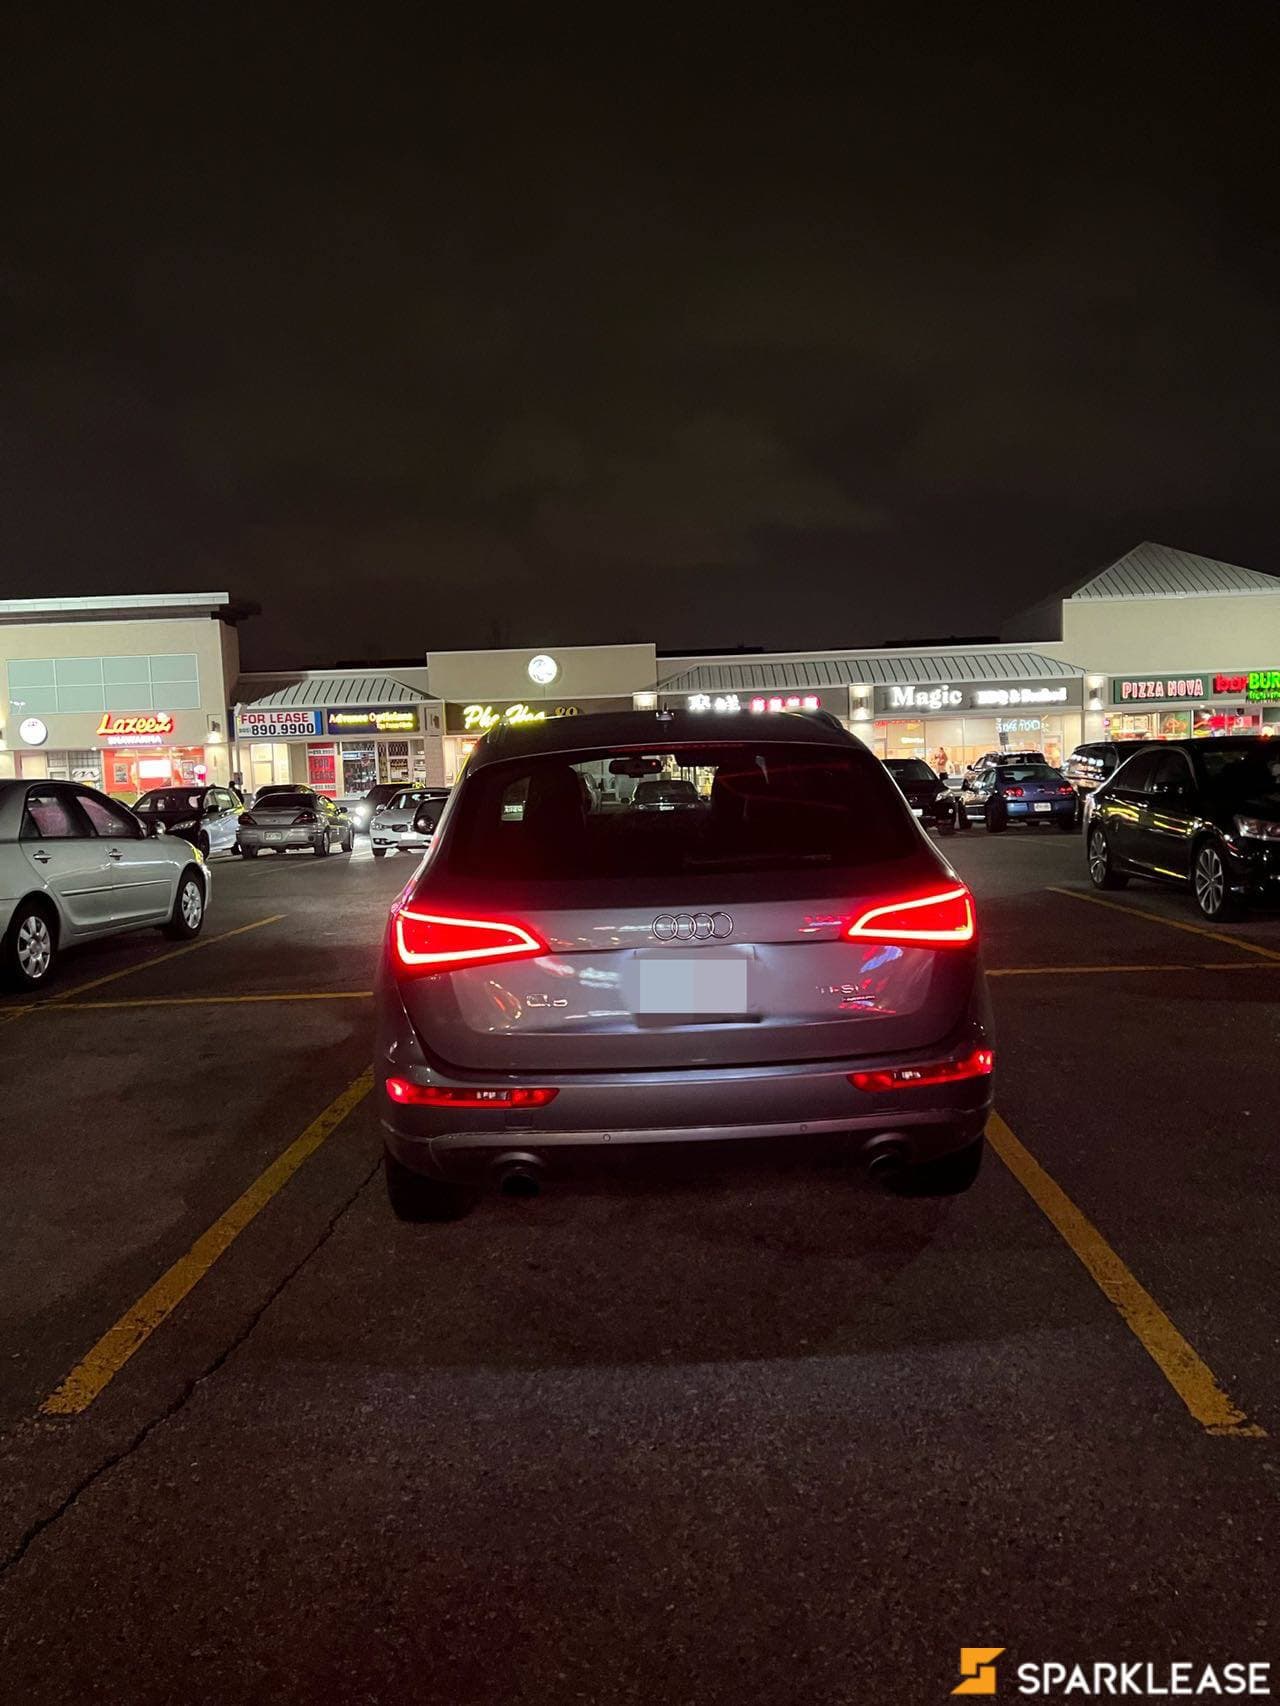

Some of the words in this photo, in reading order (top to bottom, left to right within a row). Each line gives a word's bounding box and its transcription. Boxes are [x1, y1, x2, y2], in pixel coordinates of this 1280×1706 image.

[892, 685, 963, 709] Magic
[1122, 680, 1164, 699] PIZZA
[1167, 678, 1204, 697] NOVA
[96, 713, 173, 735] Lazeez
[241, 713, 266, 724] FOR
[270, 712, 309, 723] LEASE
[251, 723, 315, 735] 890.9900
